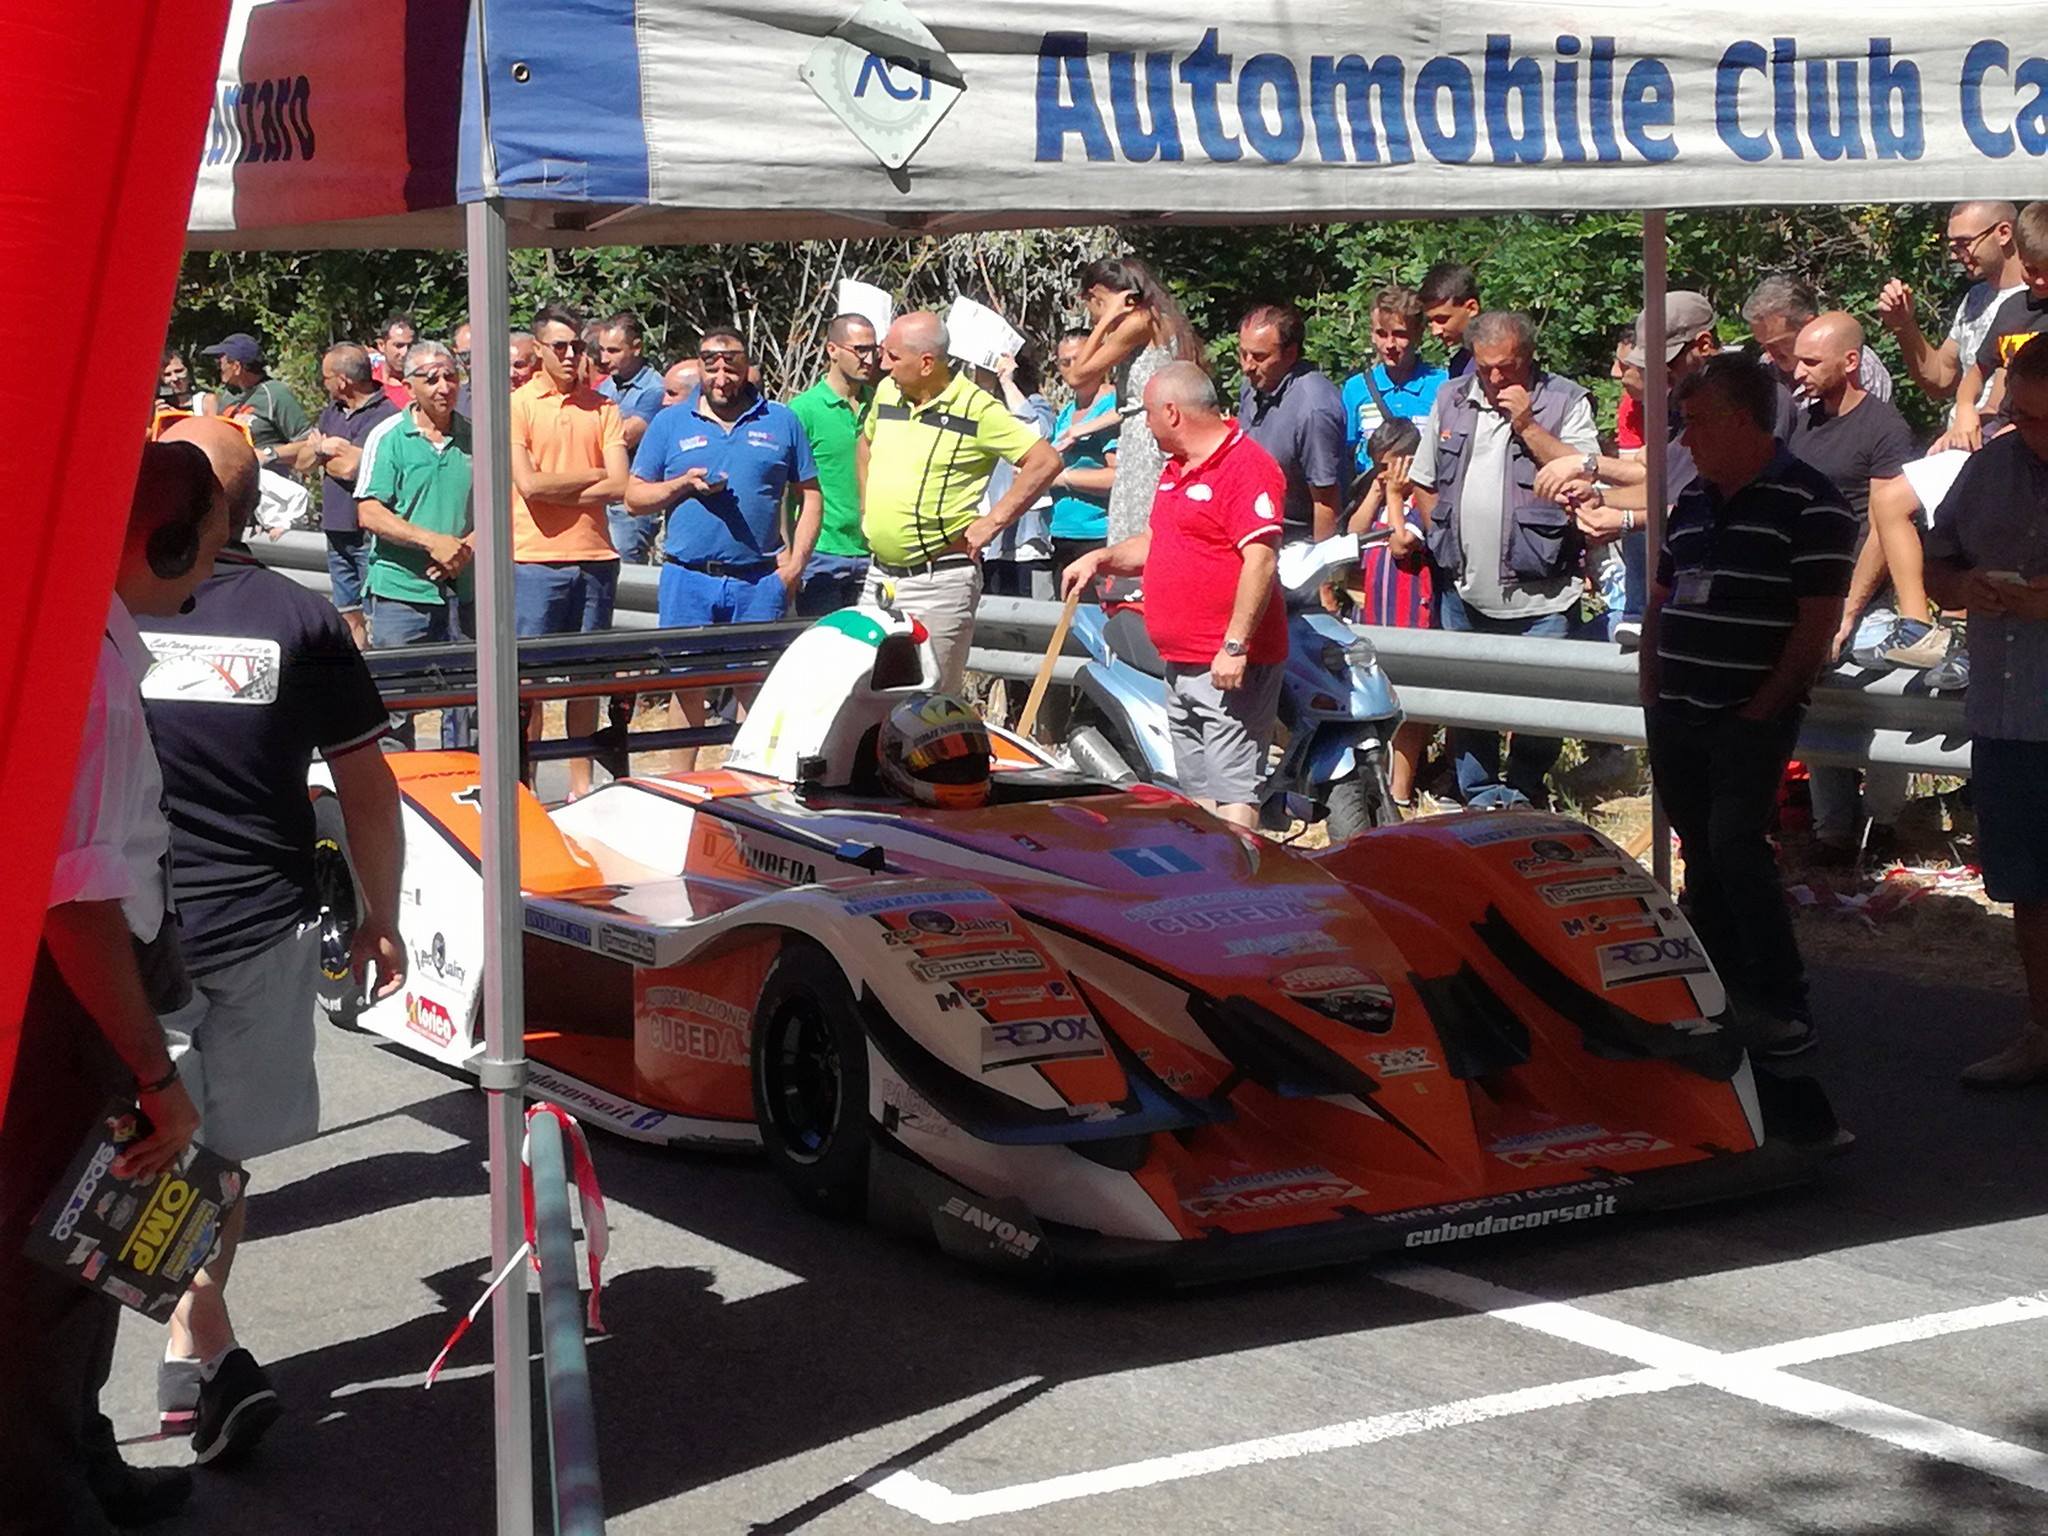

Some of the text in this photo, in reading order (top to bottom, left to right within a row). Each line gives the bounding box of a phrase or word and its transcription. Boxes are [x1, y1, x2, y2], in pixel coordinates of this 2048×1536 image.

[854, 53, 931, 101] ACI
[1034, 28, 1680, 163] Automobile
[1715, 36, 1926, 162] Club
[206, 75, 315, 166] anzaro
[1135, 847, 1182, 874] 1
[649, 1013, 742, 1066] CUBEDA
[132, 1179, 190, 1272] OMP
[962, 1205, 1041, 1252] AVON
[1405, 1194, 1619, 1248] cubedacorse.it
